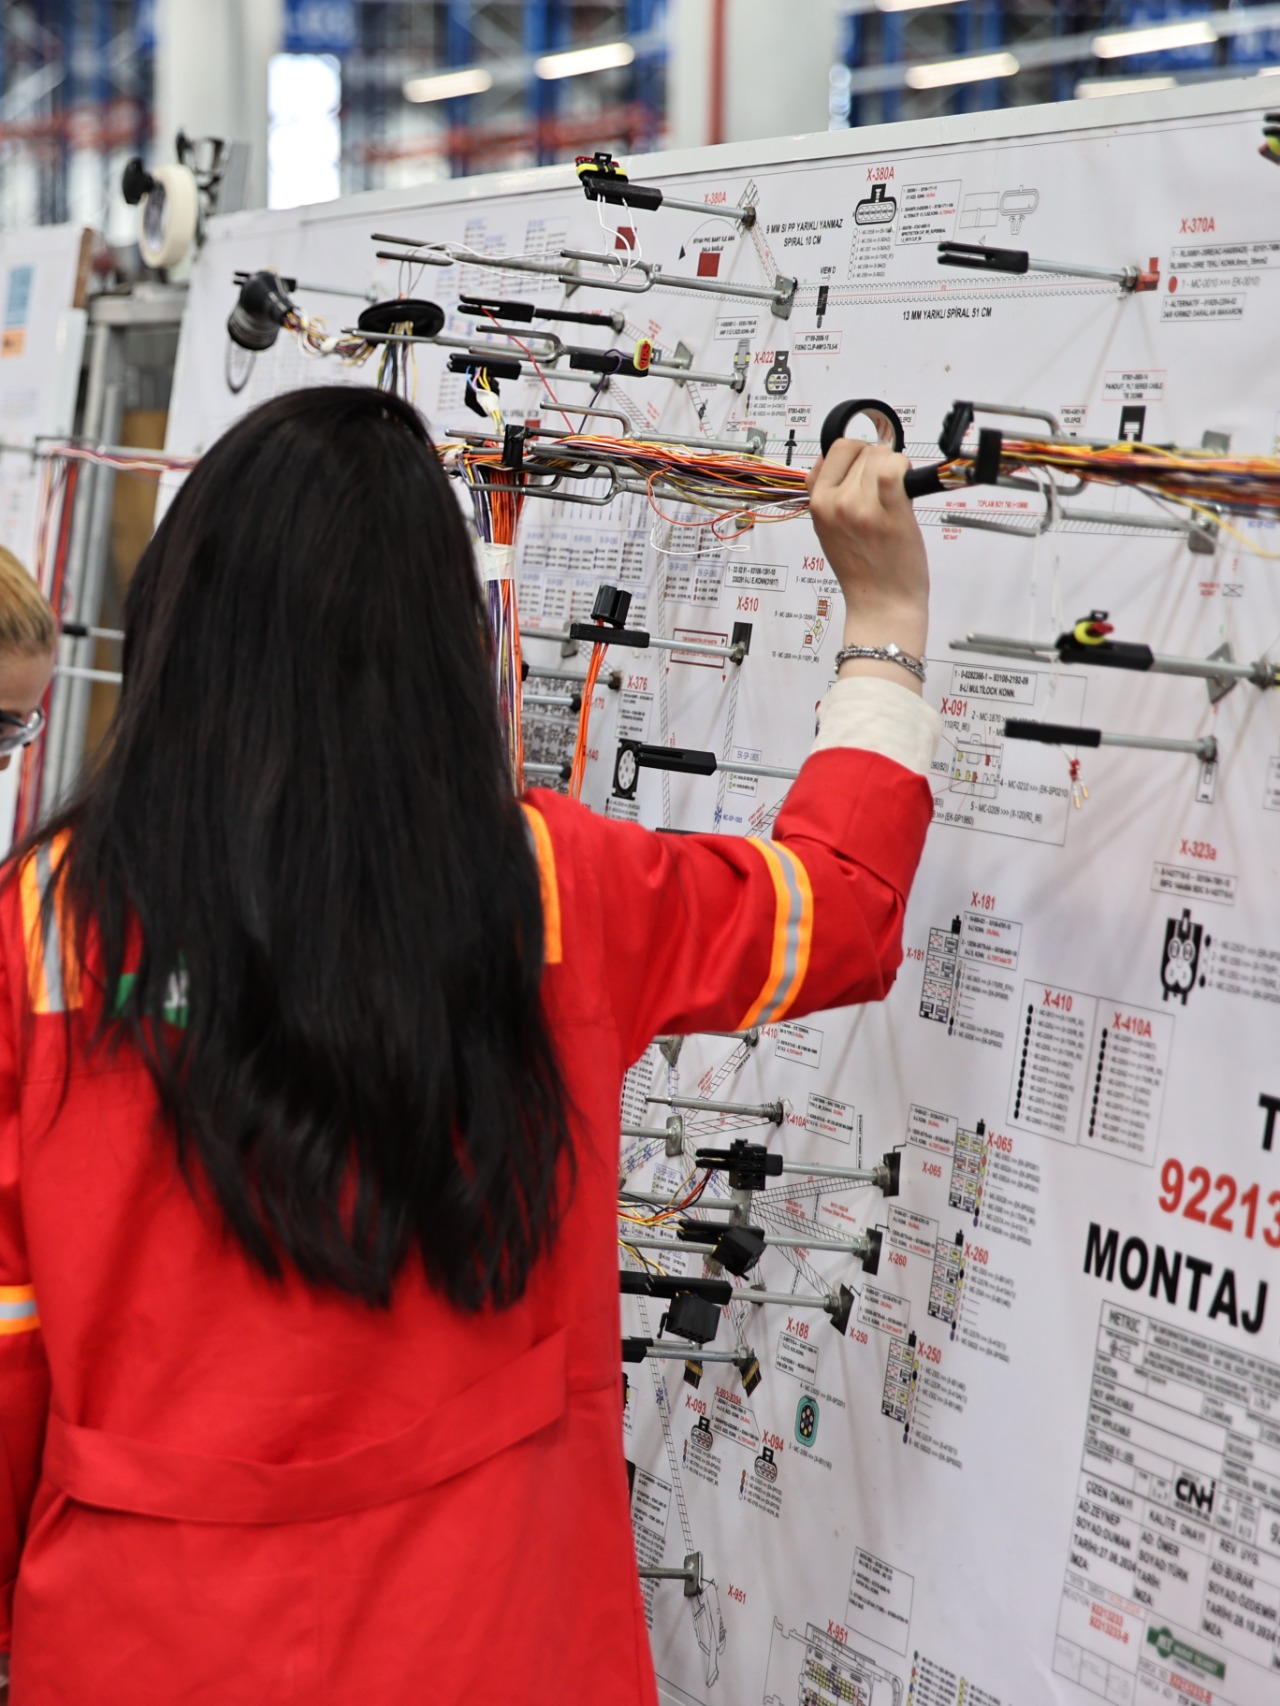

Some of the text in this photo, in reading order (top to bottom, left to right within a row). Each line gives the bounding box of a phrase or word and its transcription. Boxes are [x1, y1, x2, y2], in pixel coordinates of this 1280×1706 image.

[866, 166, 895, 181] X-380A
[766, 225, 770, 234] 9
[772, 224, 780, 234] MM
[788, 222, 796, 232] PP
[820, 218, 843, 230] YANMAZ
[1179, 216, 1216, 234] X-370A
[805, 236, 813, 245] 10
[813, 234, 822, 245] CM
[903, 311, 910, 320] 13
[911, 310, 922, 320] MM
[972, 307, 980, 318] 51
[980, 306, 992, 318] CM
[754, 351, 775, 364] X-022
[803, 556, 824, 571] X-510
[737, 596, 759, 612] X-510
[627, 675, 648, 691] X-376
[940, 697, 968, 717] X-091
[970, 891, 995, 911] X-181
[906, 947, 925, 962] X-181
[1043, 989, 1073, 1012] X-410
[760, 1025, 778, 1039] X-410
[1112, 1011, 1153, 1040] X-410A
[986, 1132, 1013, 1153] X-065
[922, 1160, 942, 1178] X-065
[888, 1250, 908, 1267] X-260
[964, 1242, 989, 1265] X-260
[1083, 1221, 1269, 1335] MONTAJ
[785, 1316, 810, 1340] X-188
[849, 1327, 868, 1346] X-250
[917, 1341, 942, 1364] X-250
[685, 1394, 707, 1416] X-093
[762, 1430, 785, 1452] X-094
[727, 1583, 747, 1605] X-951
[826, 1619, 849, 1644] X-951
